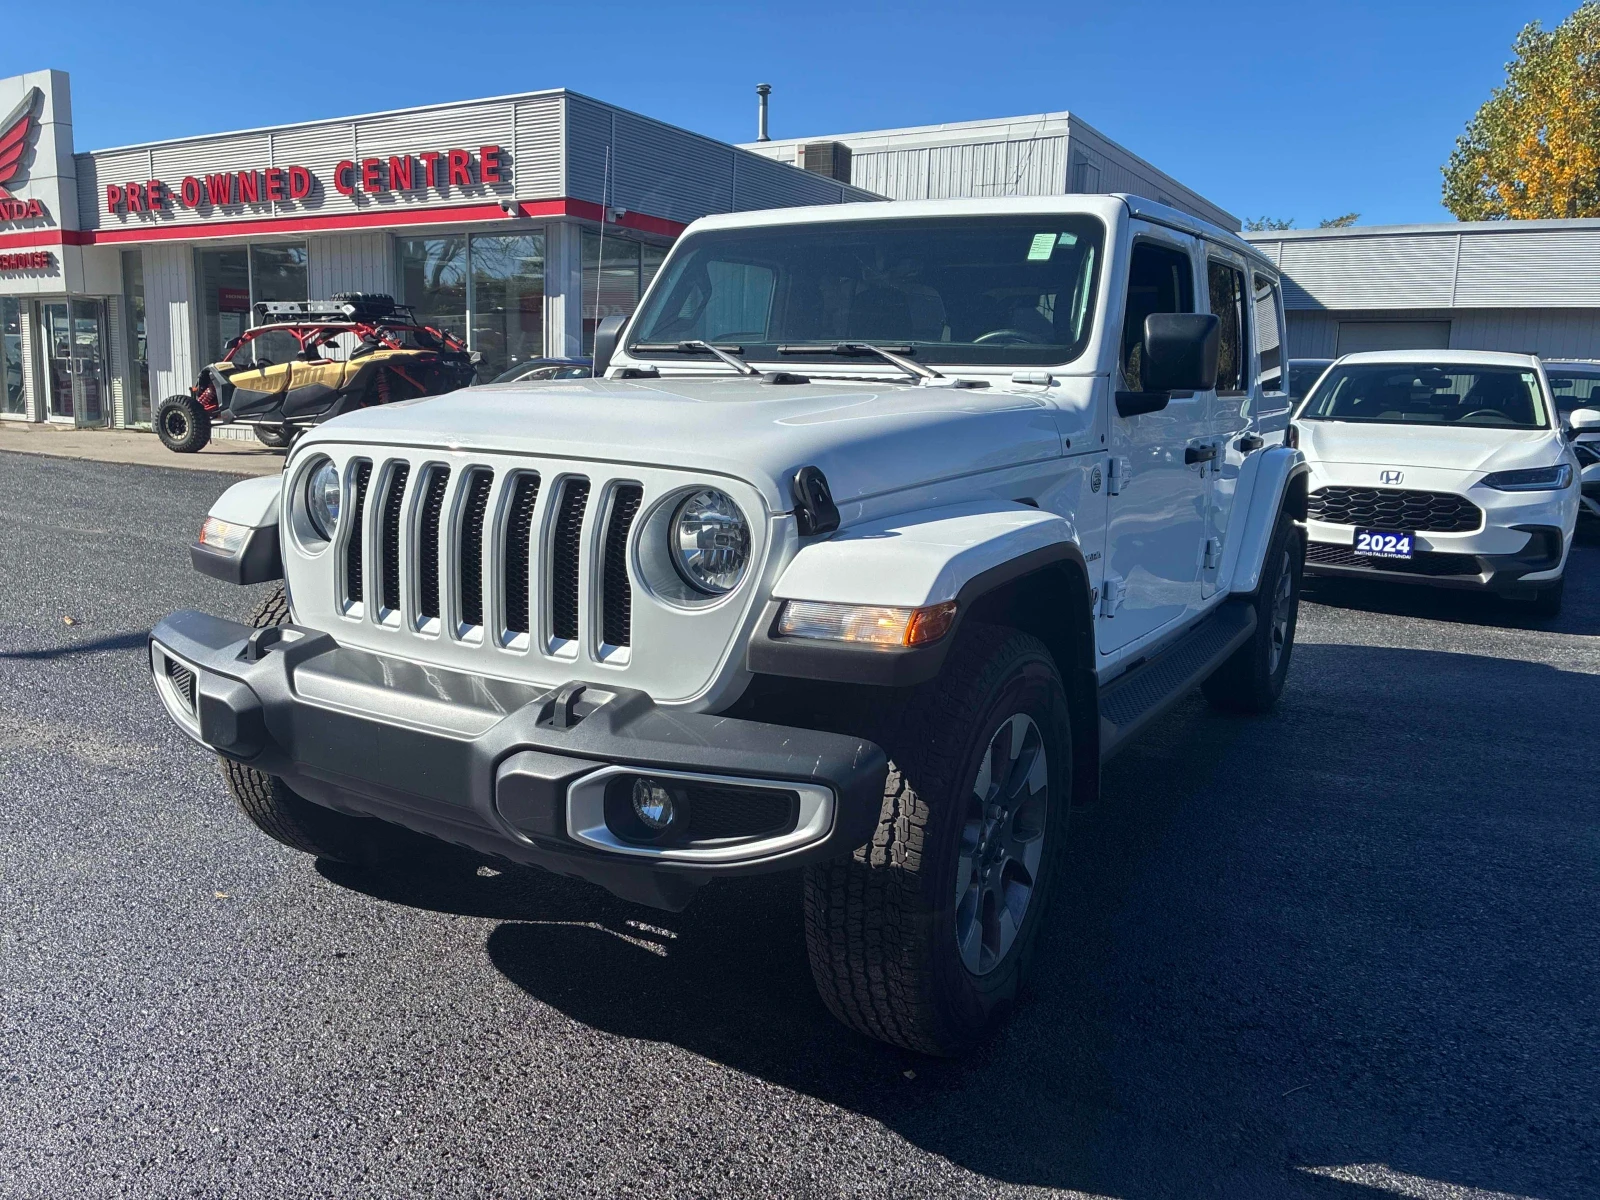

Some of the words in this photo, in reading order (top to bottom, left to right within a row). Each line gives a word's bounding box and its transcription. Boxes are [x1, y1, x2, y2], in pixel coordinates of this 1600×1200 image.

[106, 164, 311, 214] PRE-OWNED
[333, 144, 500, 197] CENTRE
[0, 251, 48, 270] RHOUSE
[1357, 533, 1410, 554] 2024
